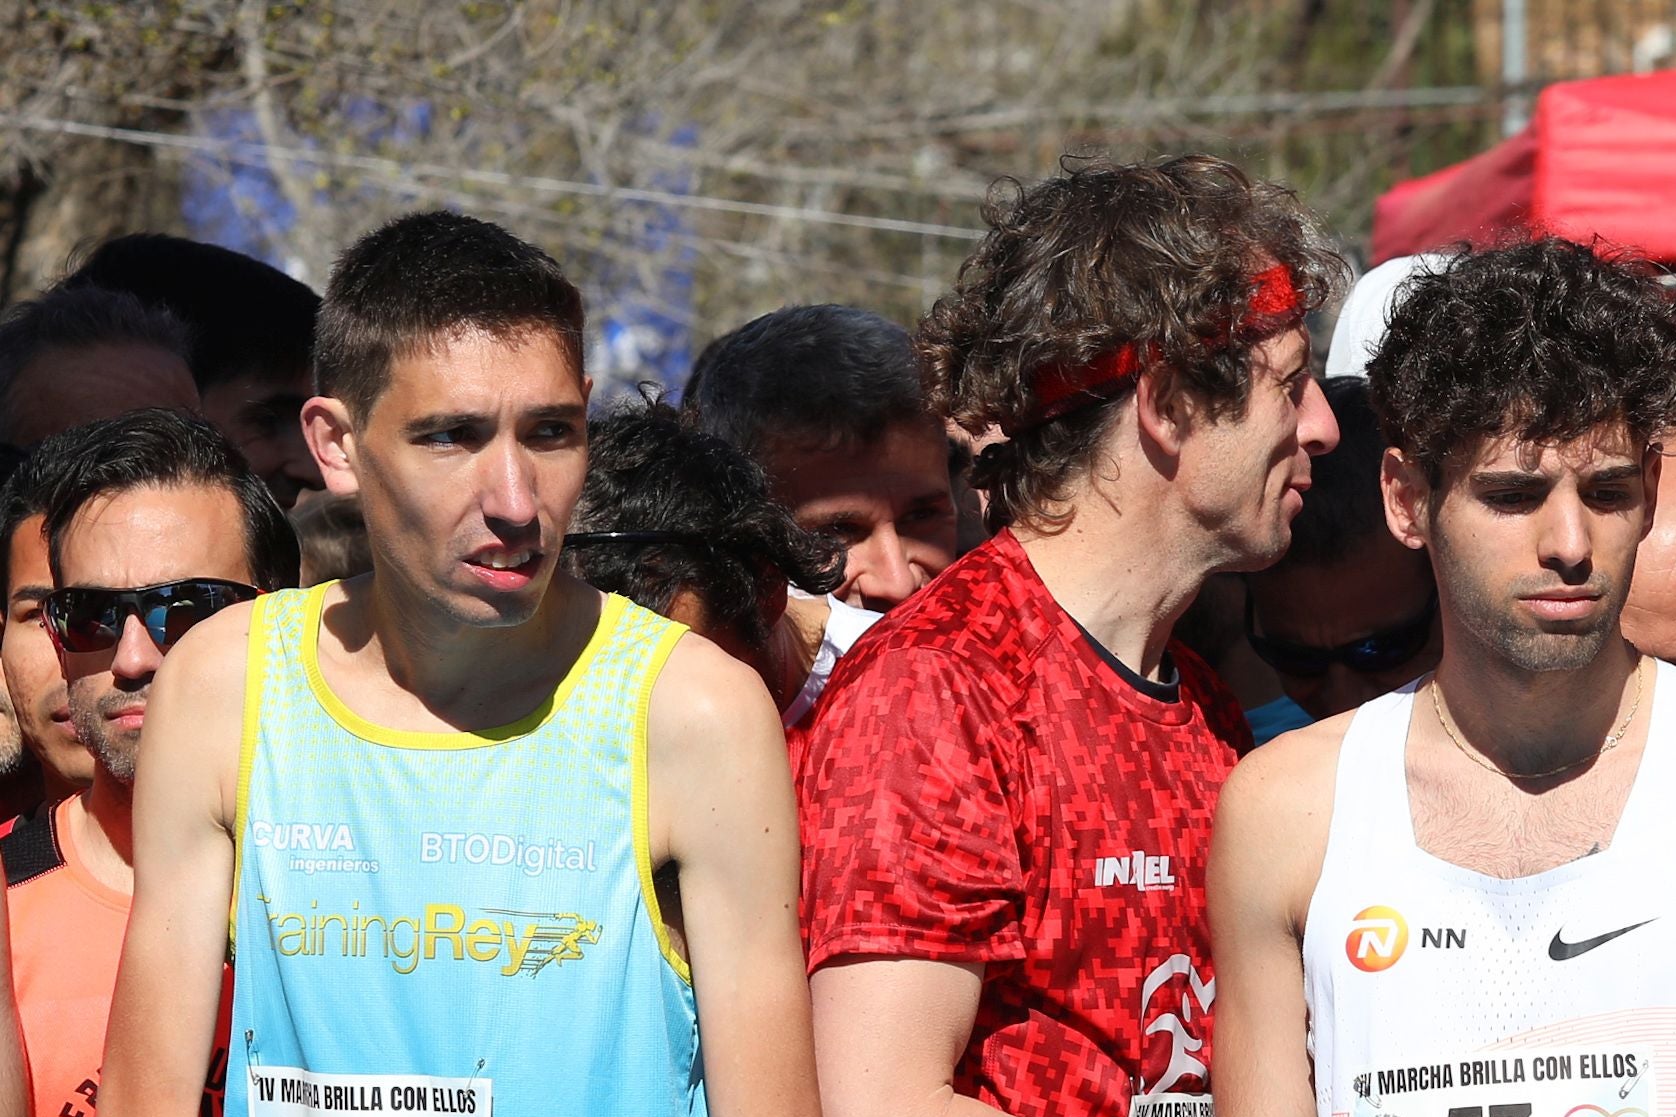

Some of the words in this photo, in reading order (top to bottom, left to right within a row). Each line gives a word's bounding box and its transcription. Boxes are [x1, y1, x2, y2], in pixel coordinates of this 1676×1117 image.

[252, 820, 355, 851] CURVA
[289, 855, 379, 874] ingenieros
[420, 831, 597, 876] BTODigital
[1421, 927, 1467, 949] NN
[1378, 1064, 1454, 1095] MARCHA
[1459, 1058, 1526, 1087] BRILLA
[1531, 1055, 1573, 1081] CON
[1579, 1053, 1638, 1079] ELLOS
[258, 1077, 275, 1101] IV
[324, 1085, 383, 1111] BRILLA
[390, 1086, 427, 1111] CON
[432, 1088, 476, 1114] ELLOS
